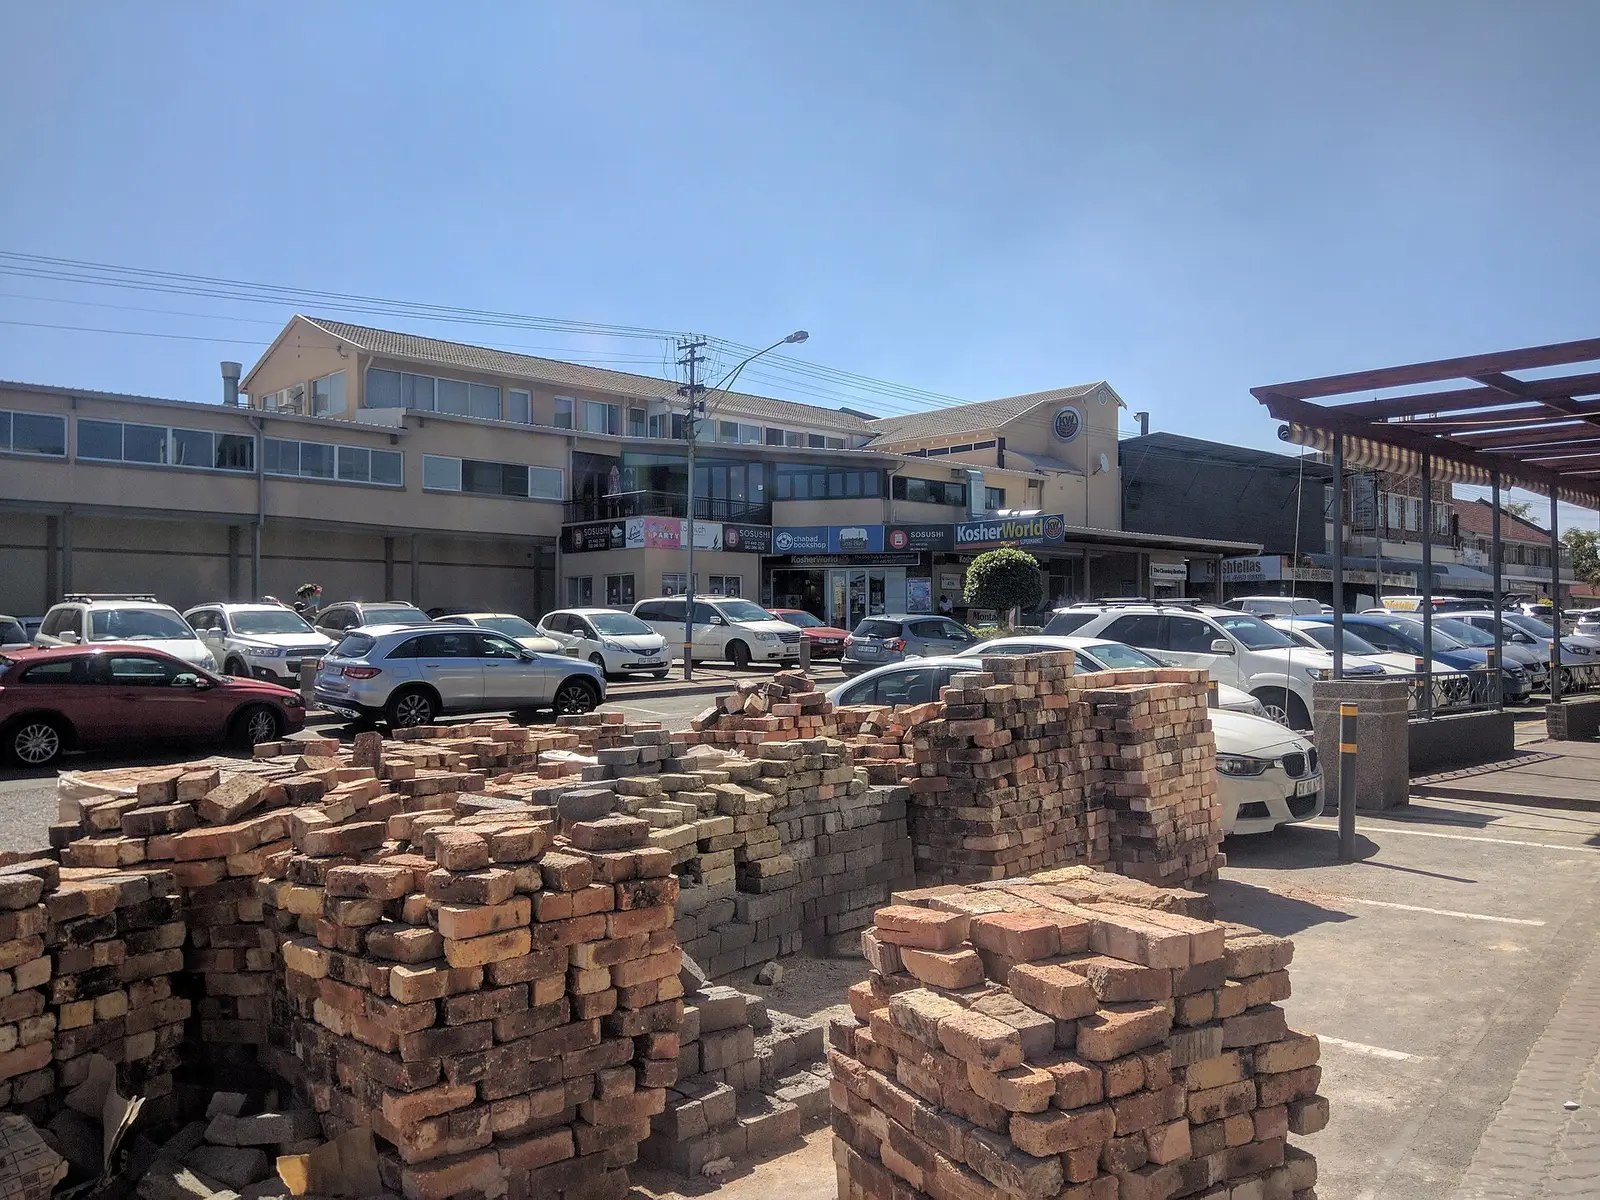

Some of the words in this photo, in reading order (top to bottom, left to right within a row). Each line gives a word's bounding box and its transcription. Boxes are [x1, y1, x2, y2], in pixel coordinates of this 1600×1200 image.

[583, 526, 610, 537] SOSUSHI
[739, 529, 771, 539] SOSUSHI
[957, 519, 1044, 541] KosherWorld
[652, 532, 680, 540] PARTY
[793, 541, 827, 549] bookshop
[791, 555, 838, 564] KosherWorld
[1206, 559, 1261, 574] Frshfellas
